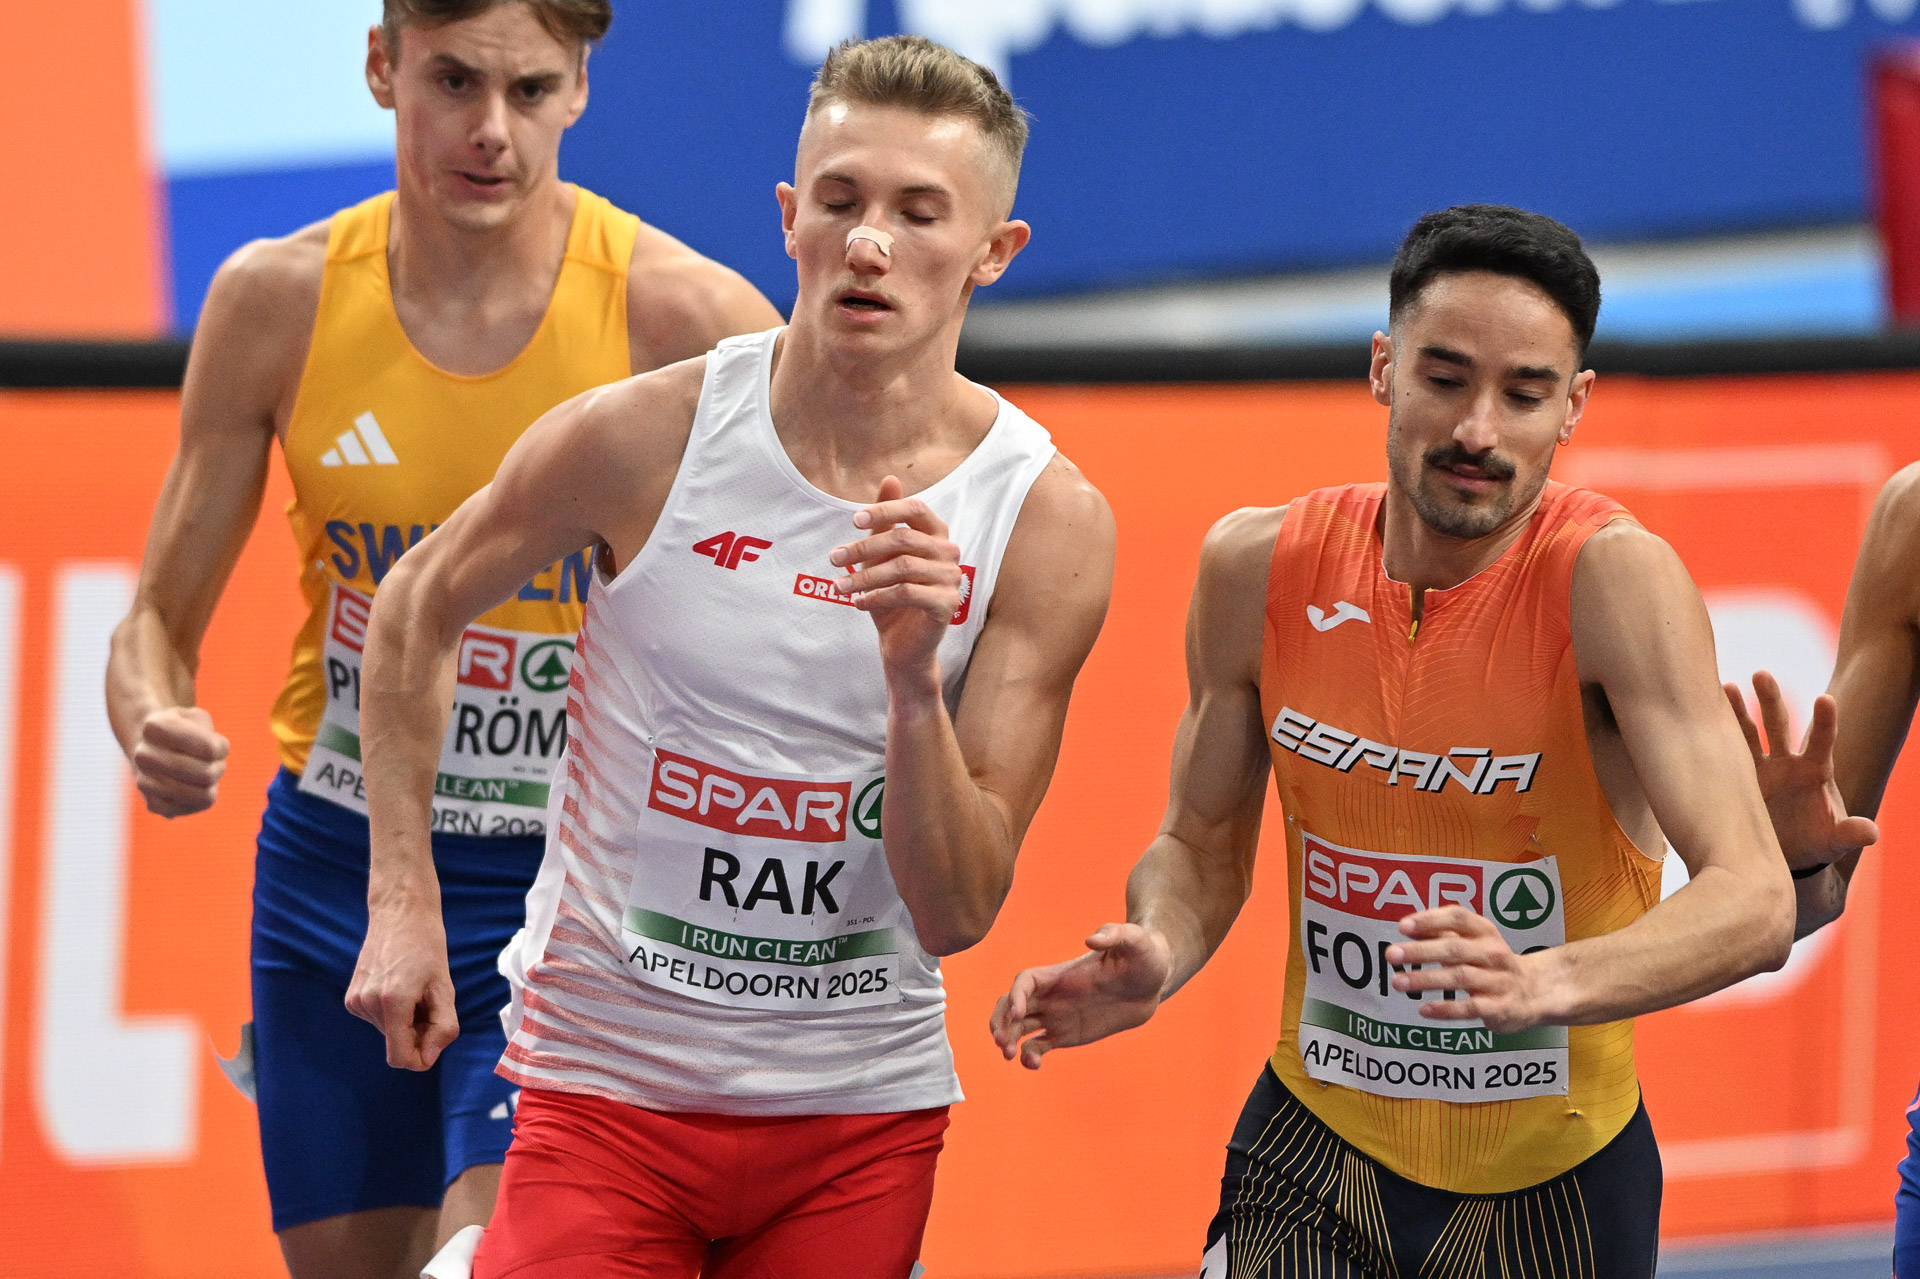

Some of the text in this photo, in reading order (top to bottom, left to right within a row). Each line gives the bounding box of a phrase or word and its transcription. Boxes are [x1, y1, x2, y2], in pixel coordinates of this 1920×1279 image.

[692, 530, 774, 571] 4F
[1270, 706, 1542, 795] ESPAÑA
[655, 759, 845, 833] SPAR
[698, 846, 846, 915] RAK
[1308, 850, 1478, 913] SPAR
[681, 924, 687, 944] I
[692, 929, 748, 957] RUN
[629, 945, 889, 1000] APELDOORN 2025
[1348, 1014, 1493, 1050] I RUN CLEAN
[1304, 1038, 1558, 1090] APELDOORN 2025
